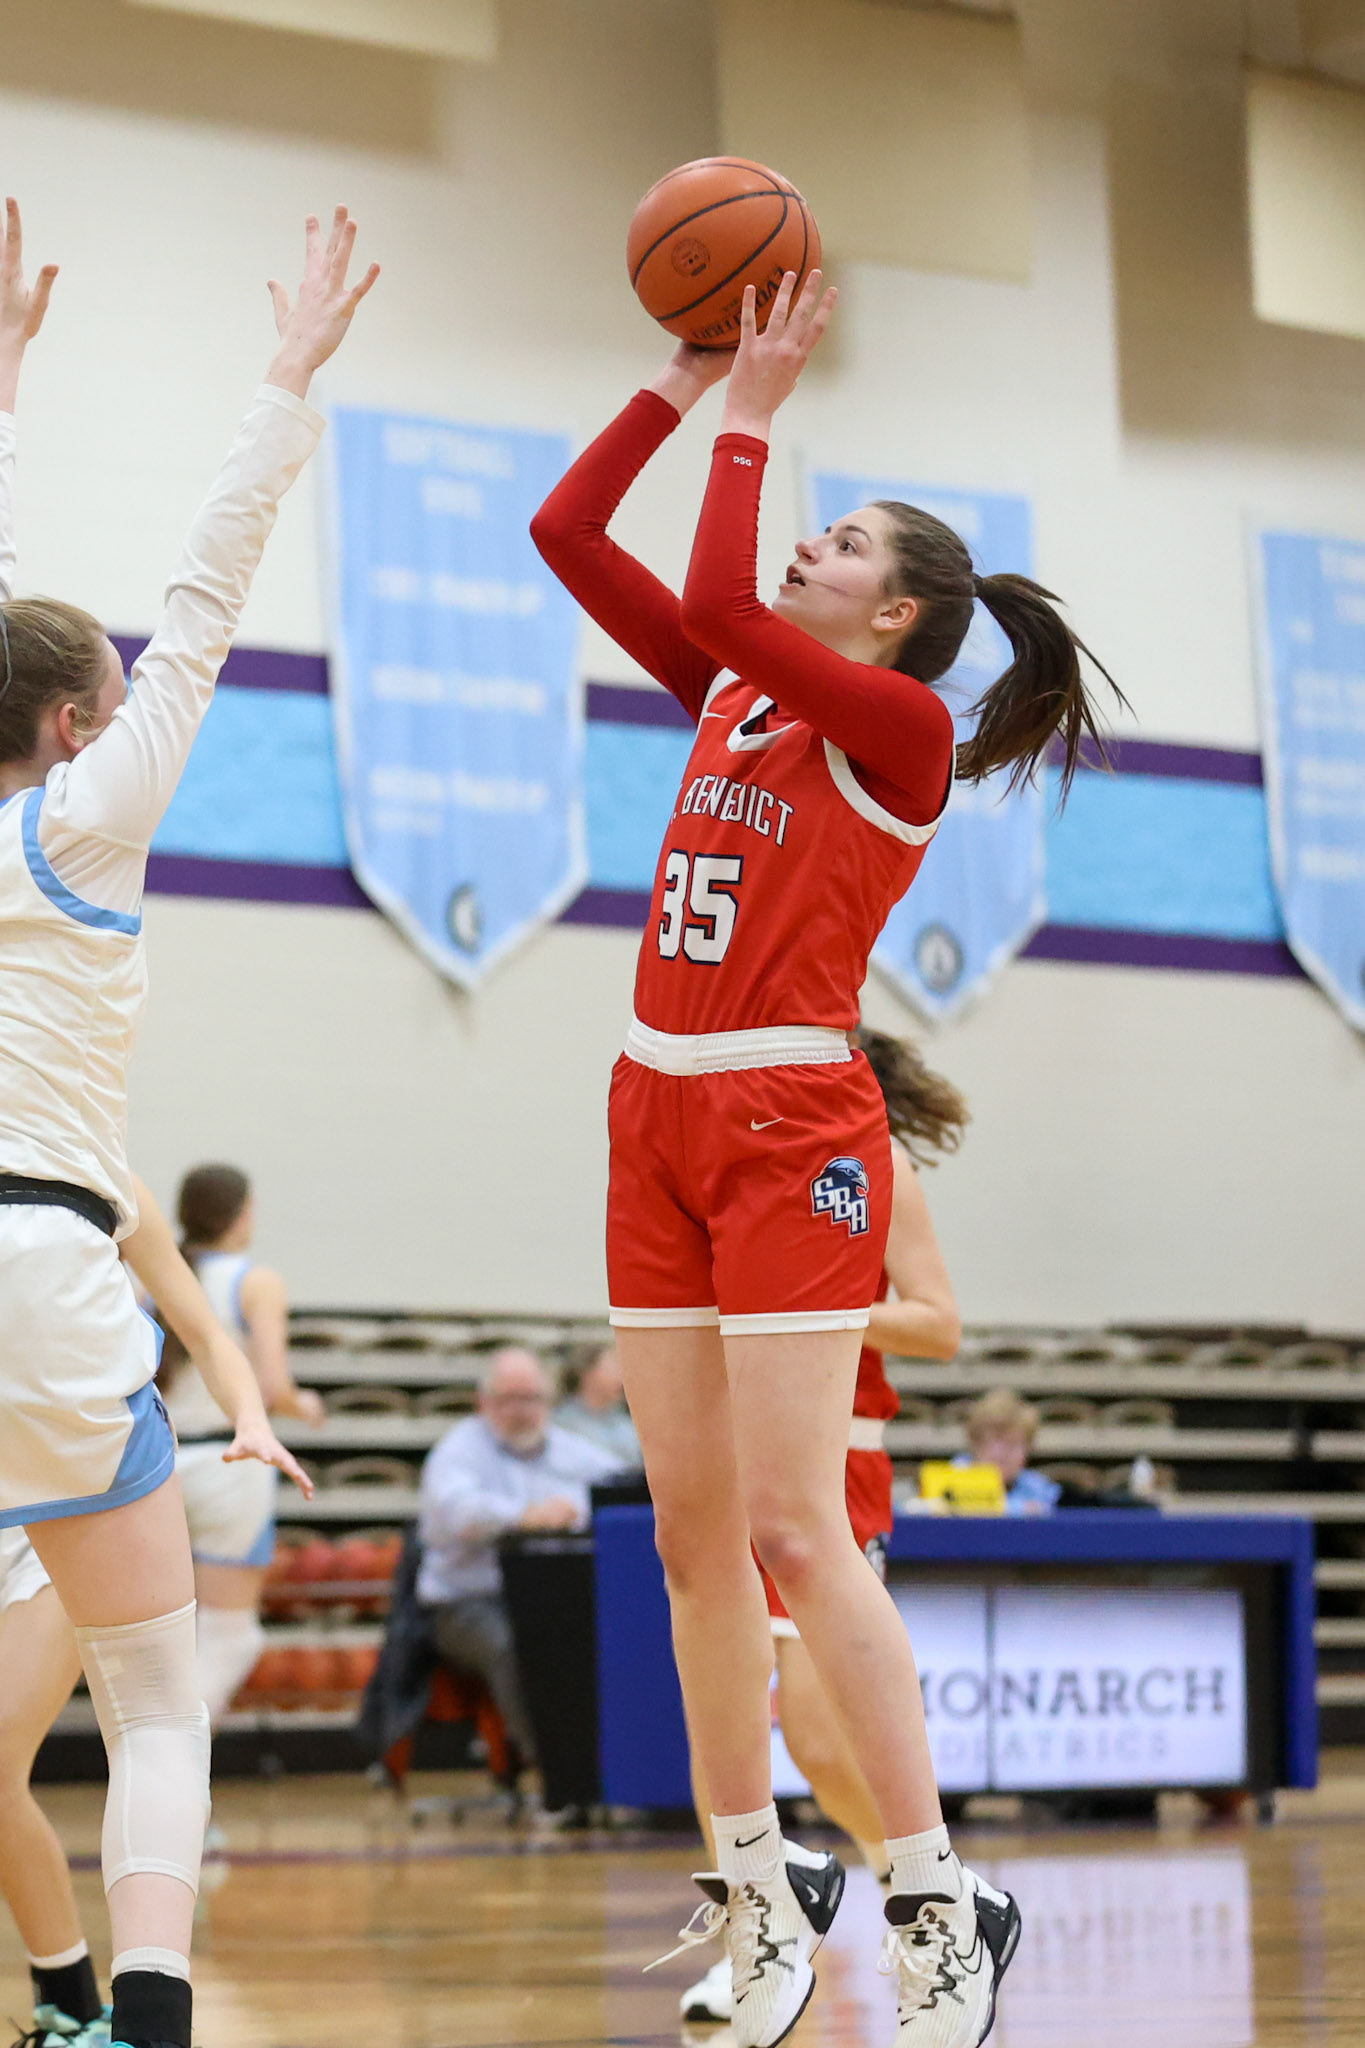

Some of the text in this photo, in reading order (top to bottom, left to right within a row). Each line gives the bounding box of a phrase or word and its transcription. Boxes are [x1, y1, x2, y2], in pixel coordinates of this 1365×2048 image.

[733, 456, 752, 467] DSG
[658, 849, 744, 966] 35
[813, 1176, 867, 1233] SBA
[936, 1726, 1170, 1768] DIATRICS
